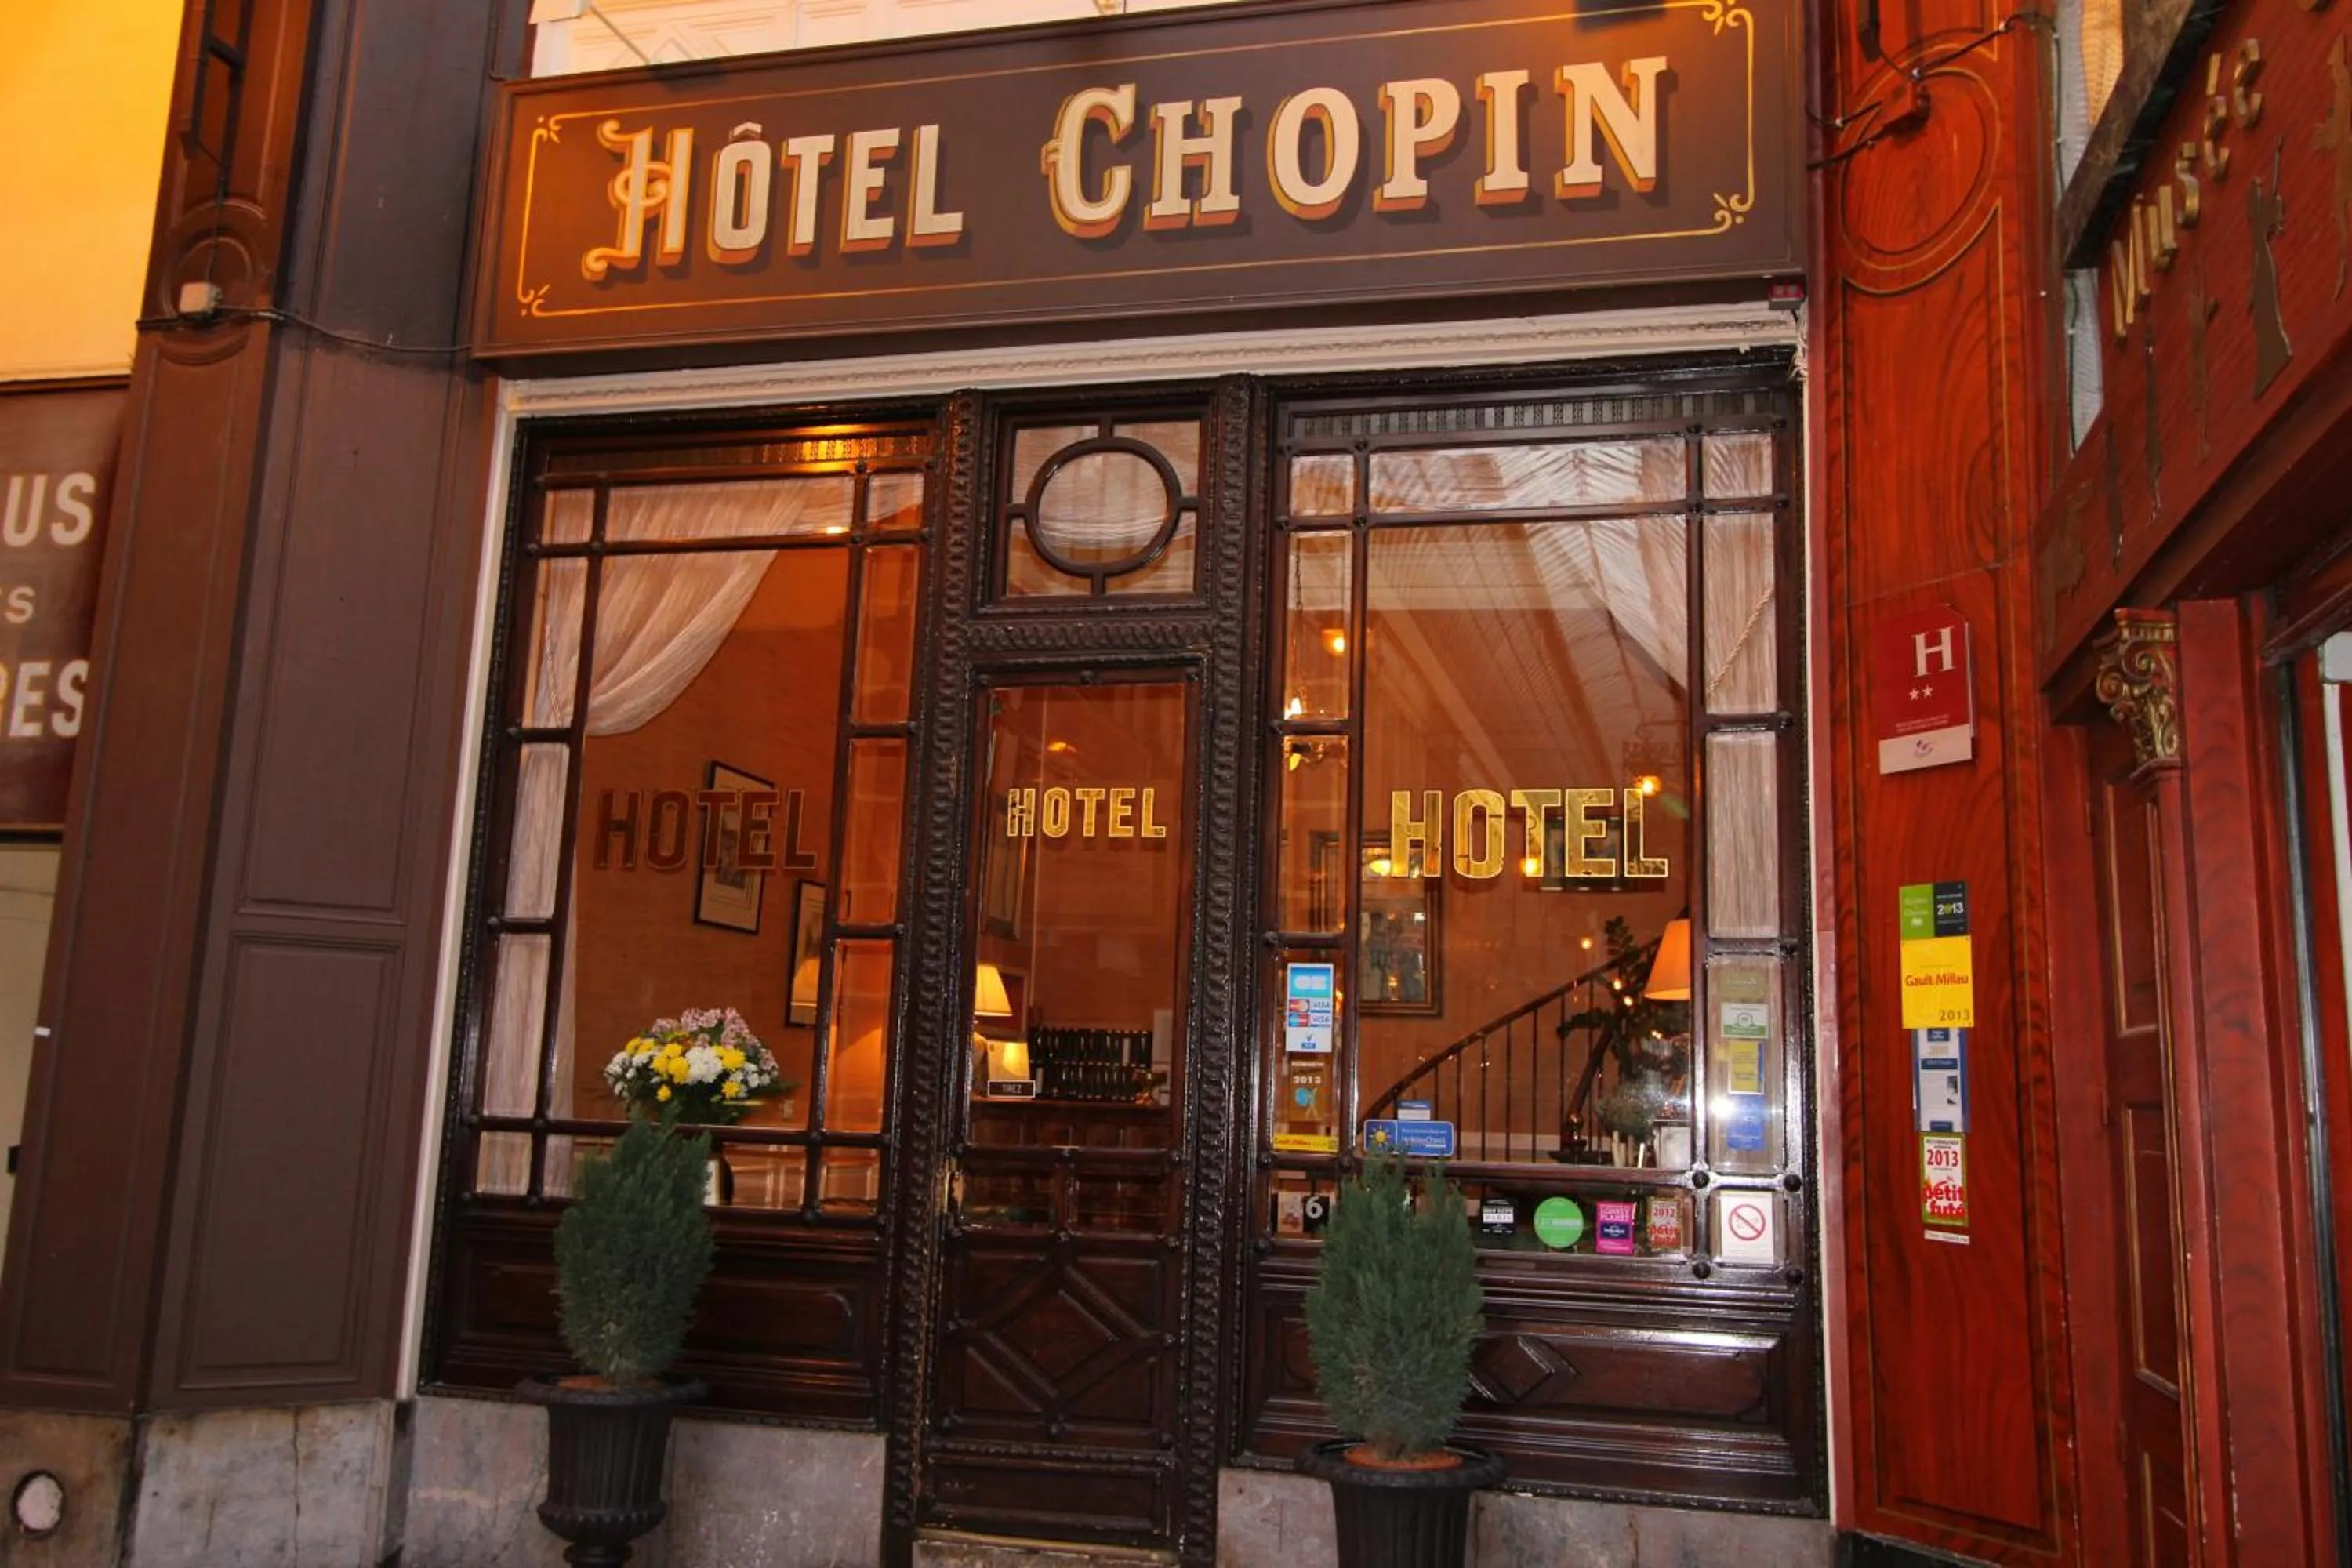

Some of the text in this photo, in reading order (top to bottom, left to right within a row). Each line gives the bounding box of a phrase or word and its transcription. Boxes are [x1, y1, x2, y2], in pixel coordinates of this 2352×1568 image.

[582, 56, 1668, 282] HÔTEL CHOPIN
[1911, 626, 1956, 677] H
[593, 788, 817, 872] HOTEL
[1007, 787, 1166, 838] HOTEL
[1392, 788, 1668, 878] HOTEL
[1939, 1009, 1970, 1022] 2013
[1926, 1149, 1958, 1167] 2013
